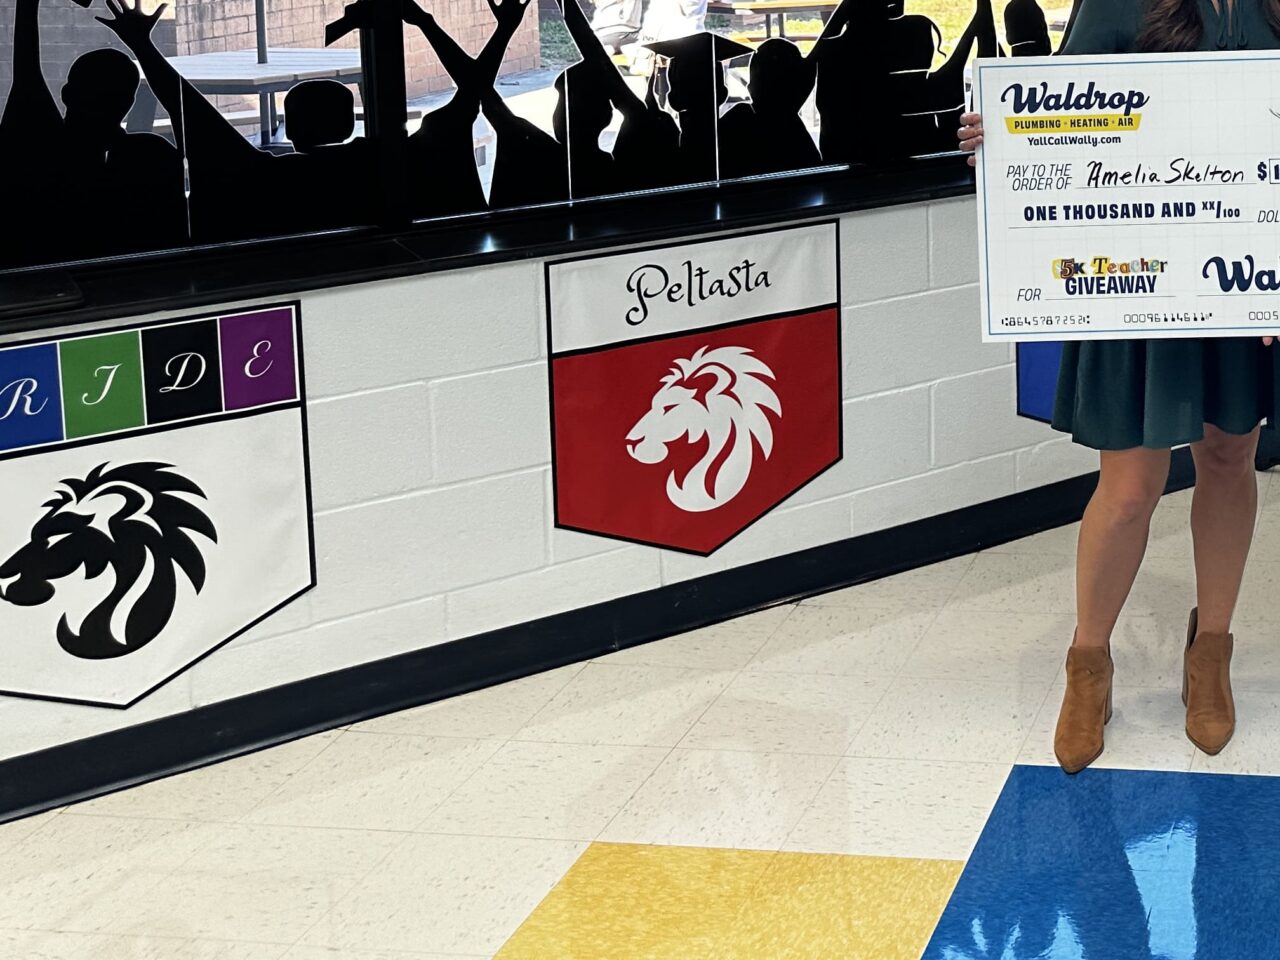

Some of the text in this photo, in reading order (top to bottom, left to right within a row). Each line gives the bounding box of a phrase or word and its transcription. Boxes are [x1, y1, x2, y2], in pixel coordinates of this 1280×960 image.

[1001, 82, 1150, 116] Waldrop
[1014, 117, 1134, 130] PLUMBING HEATING AIR
[1027, 135, 1122, 147] YallCallWally.com
[1006, 163, 1073, 179] PAY TO THE
[1087, 157, 1245, 188] Amelia Skelton
[1012, 177, 1073, 191] ORDER OF
[1024, 205, 1058, 221] ONE
[1063, 203, 1155, 220] THOUSAND
[1161, 202, 1196, 218] AND
[1093, 256, 1168, 275] Teacher
[626, 260, 771, 325] Peltasta
[1065, 275, 1157, 296] GIVEAWAY
[1017, 288, 1042, 301] FOR
[1249, 311, 1279, 321] 0005
